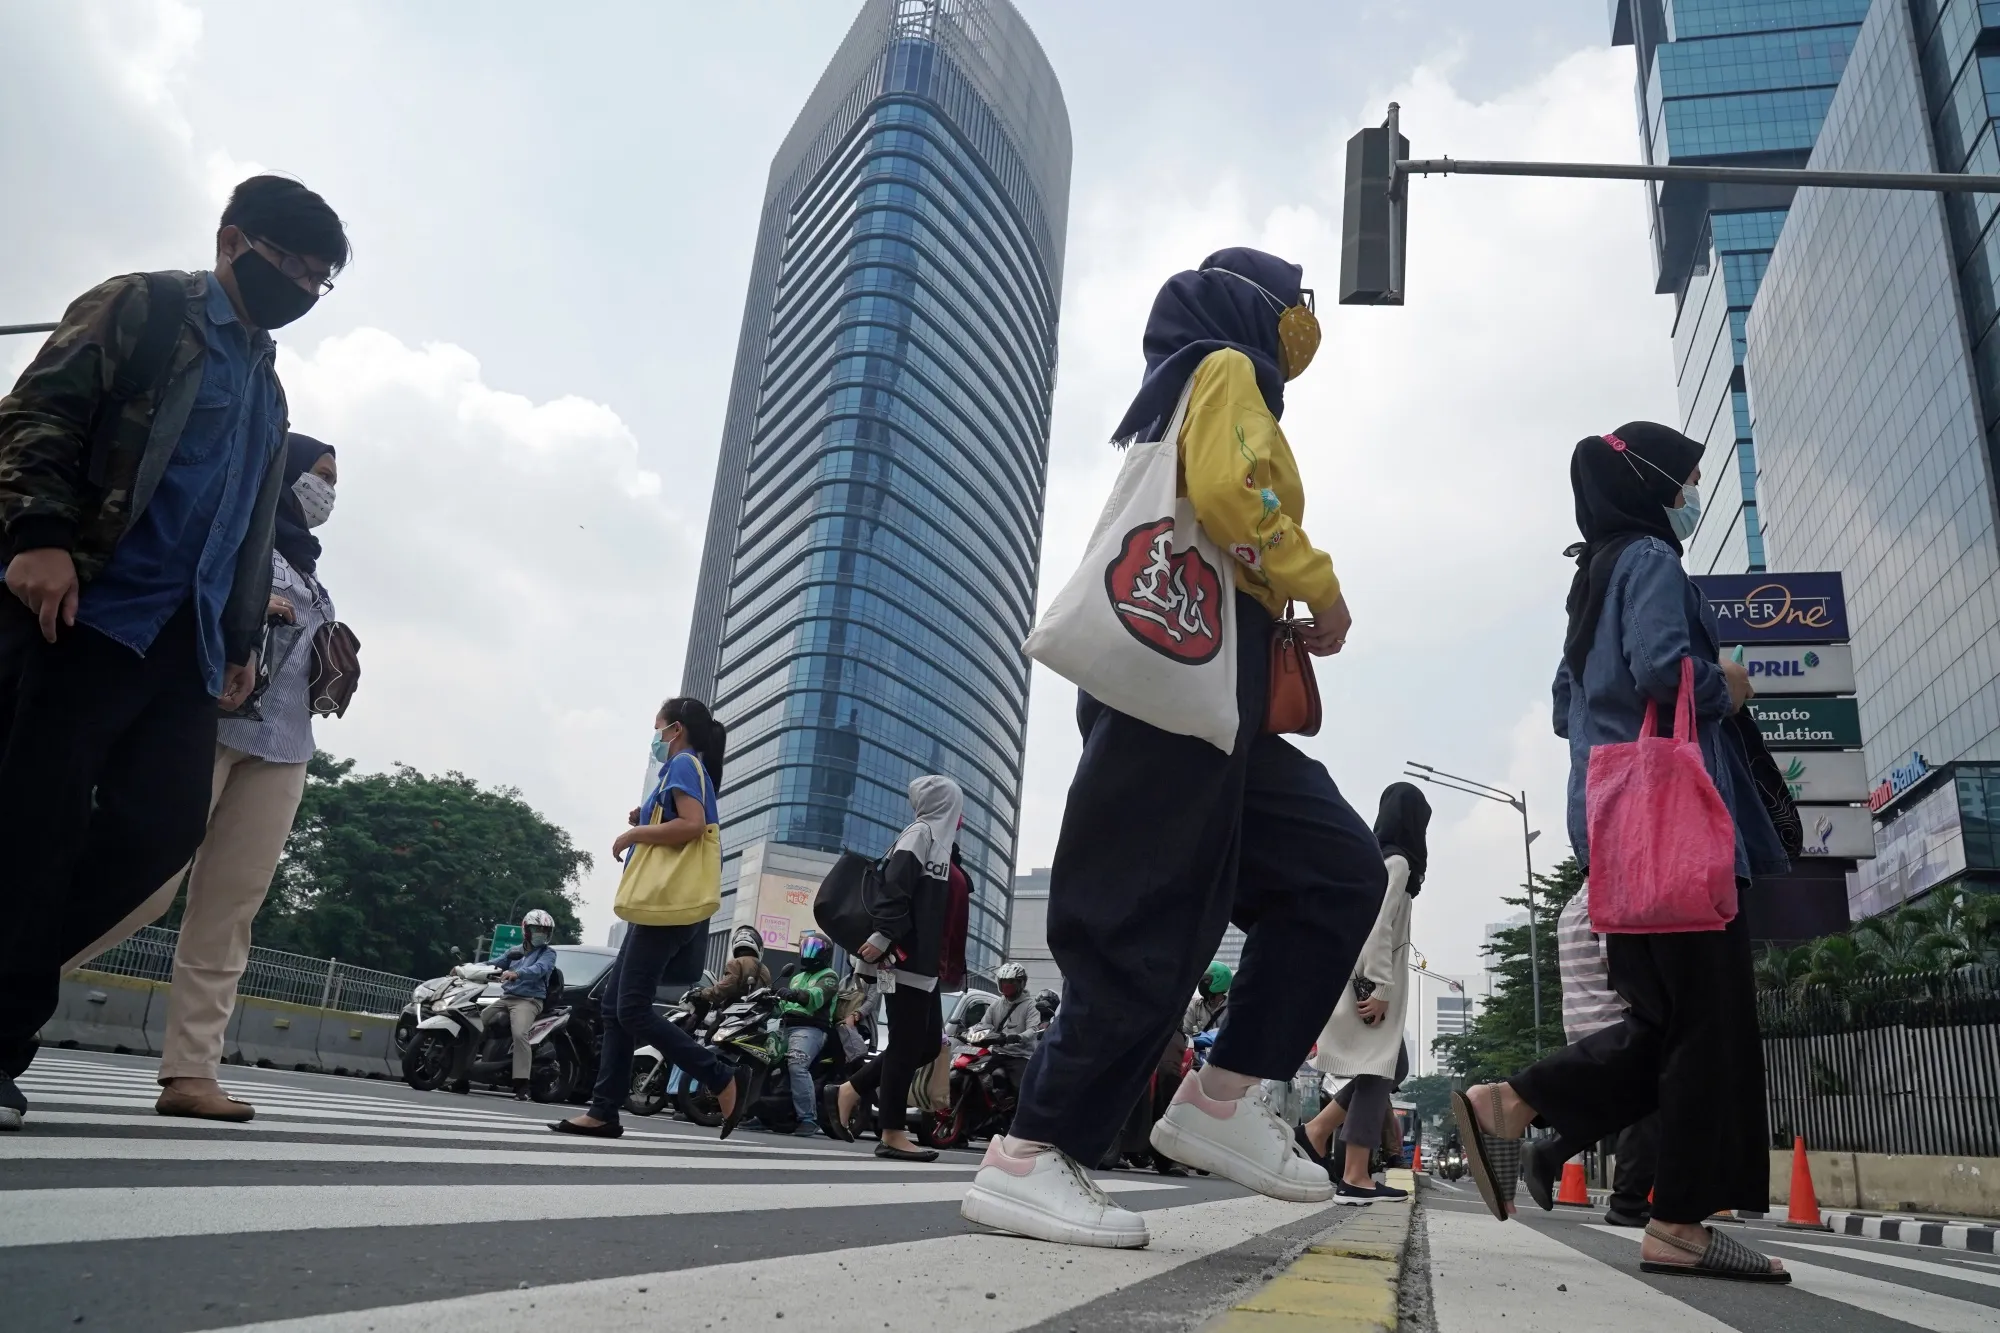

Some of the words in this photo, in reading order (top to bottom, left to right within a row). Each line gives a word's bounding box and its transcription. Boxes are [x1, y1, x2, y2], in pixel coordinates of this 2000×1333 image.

[1748, 660, 1805, 677] PRIL
[1747, 705, 1810, 721] Tanoto
[1761, 723, 1835, 741] ndation
